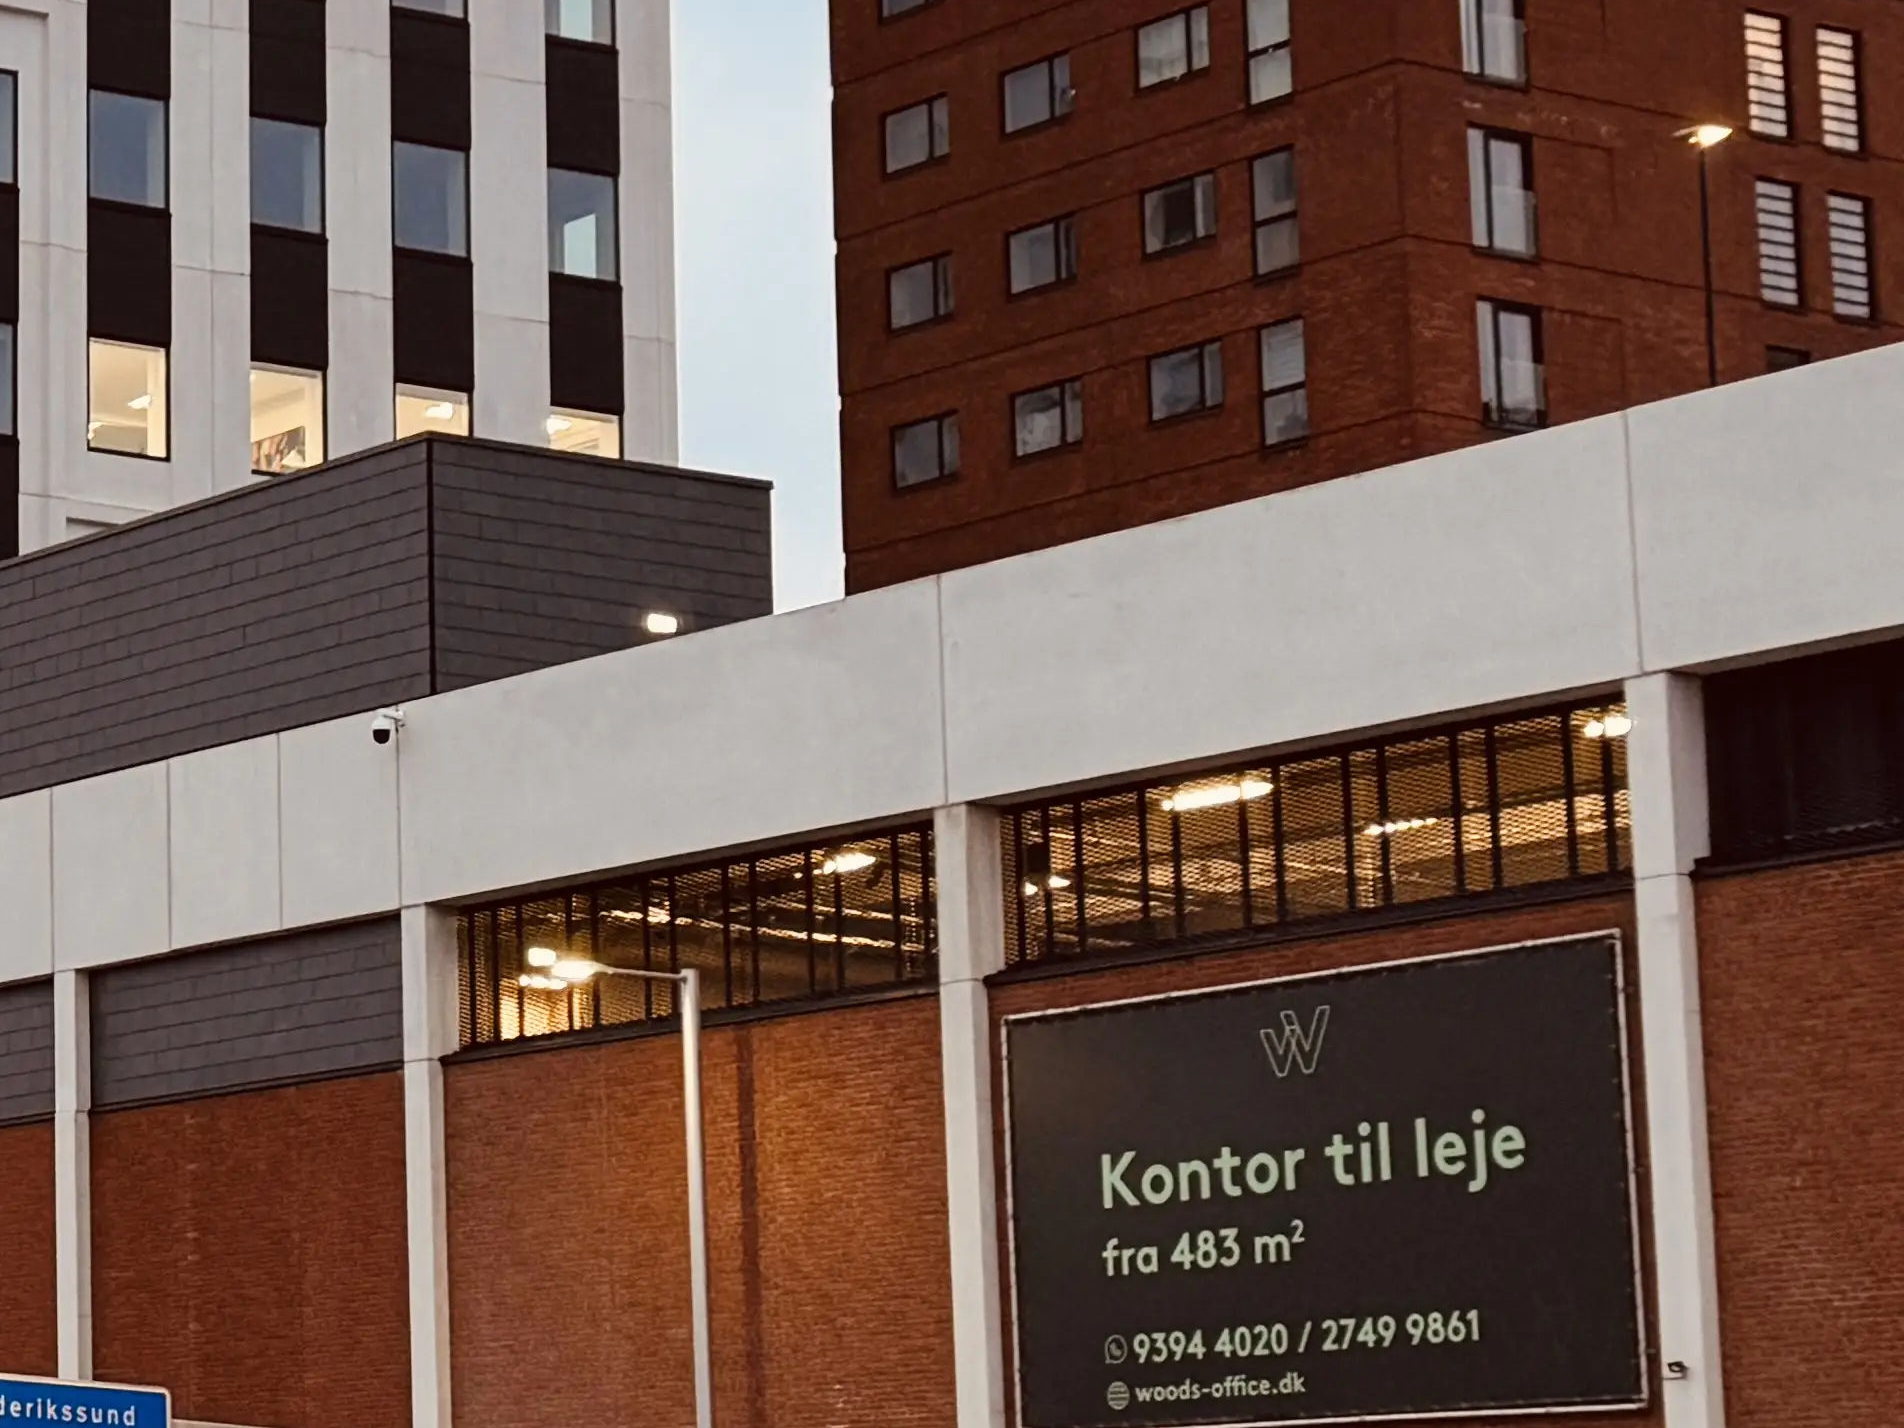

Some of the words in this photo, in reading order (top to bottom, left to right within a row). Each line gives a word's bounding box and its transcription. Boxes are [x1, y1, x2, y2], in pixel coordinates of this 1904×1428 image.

[1101, 1148, 1305, 1209] Kontor
[1324, 1122, 1391, 1185] til
[1415, 1109, 1526, 1192] leje
[1102, 1237, 1159, 1277] fra
[1170, 1227, 1241, 1270] 483
[1133, 1329, 1206, 1363] 9394
[1214, 1323, 1289, 1358] 4020
[1322, 1315, 1396, 1350] 2749
[1405, 1309, 1480, 1345] 9861
[1135, 1372, 1307, 1403] woods-office.dk
